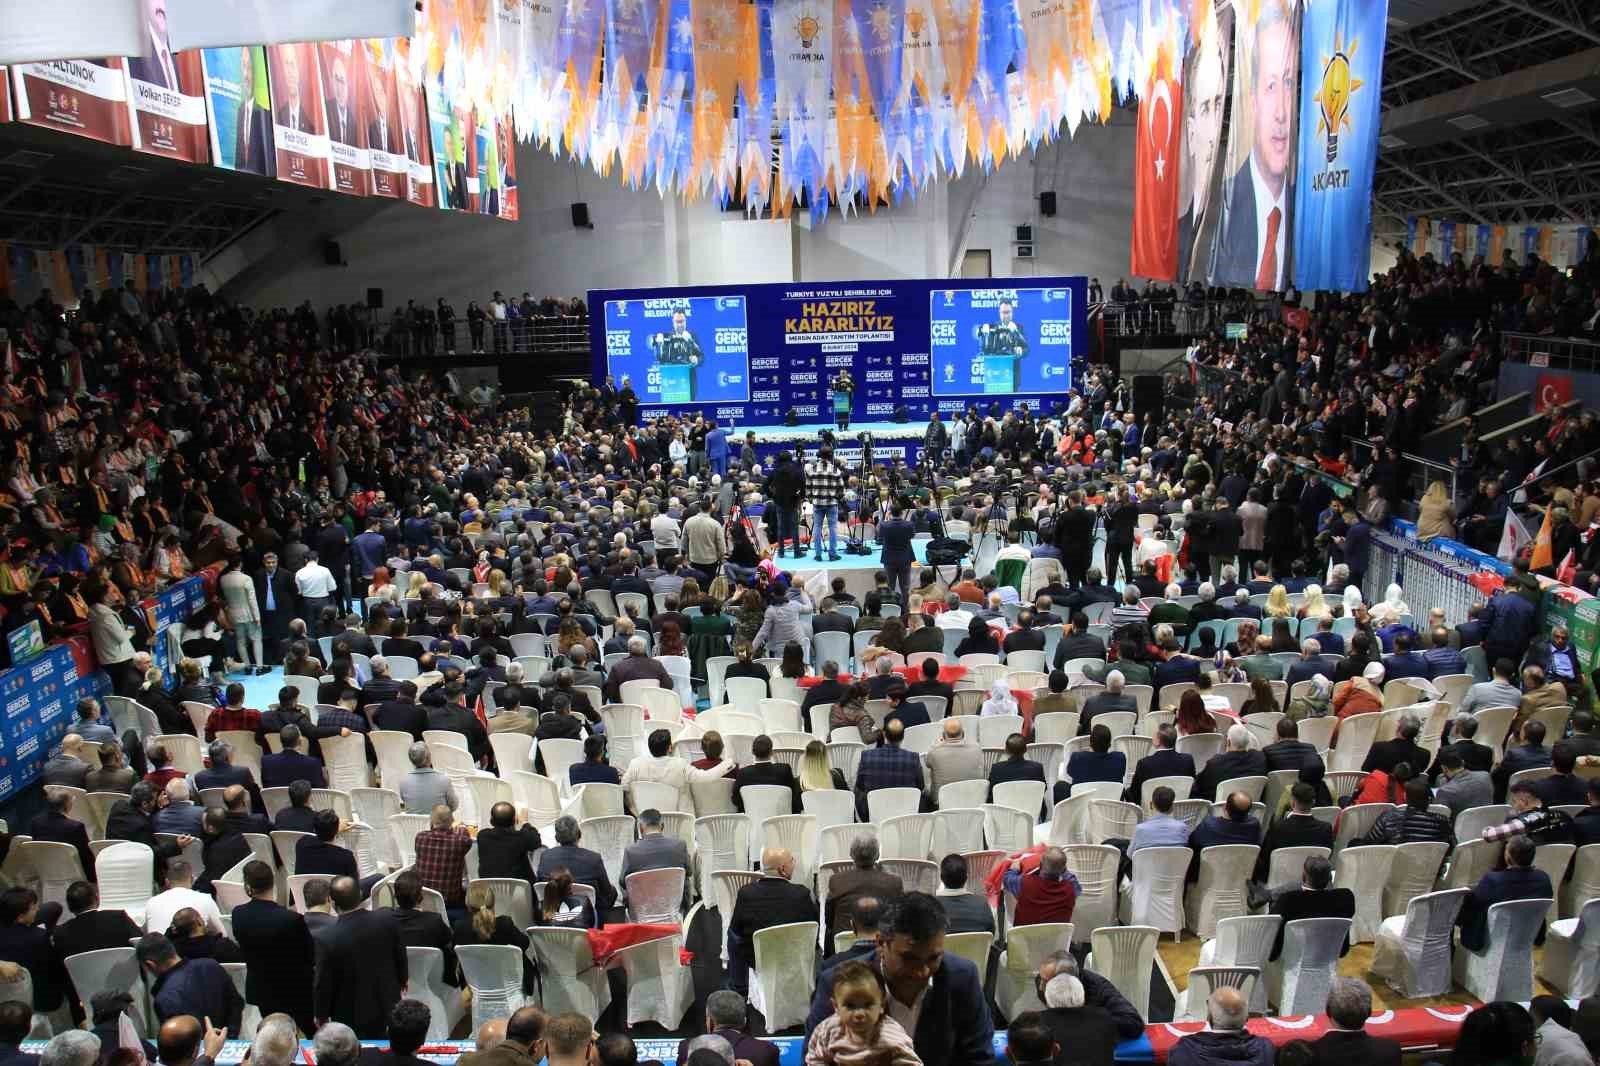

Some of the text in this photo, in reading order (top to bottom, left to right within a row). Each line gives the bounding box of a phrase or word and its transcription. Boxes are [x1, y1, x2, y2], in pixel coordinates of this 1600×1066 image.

[138, 84, 162, 103] Volkan
[802, 301, 876, 317] HAZIRIZ
[785, 315, 894, 333] KARARLIYIZ
